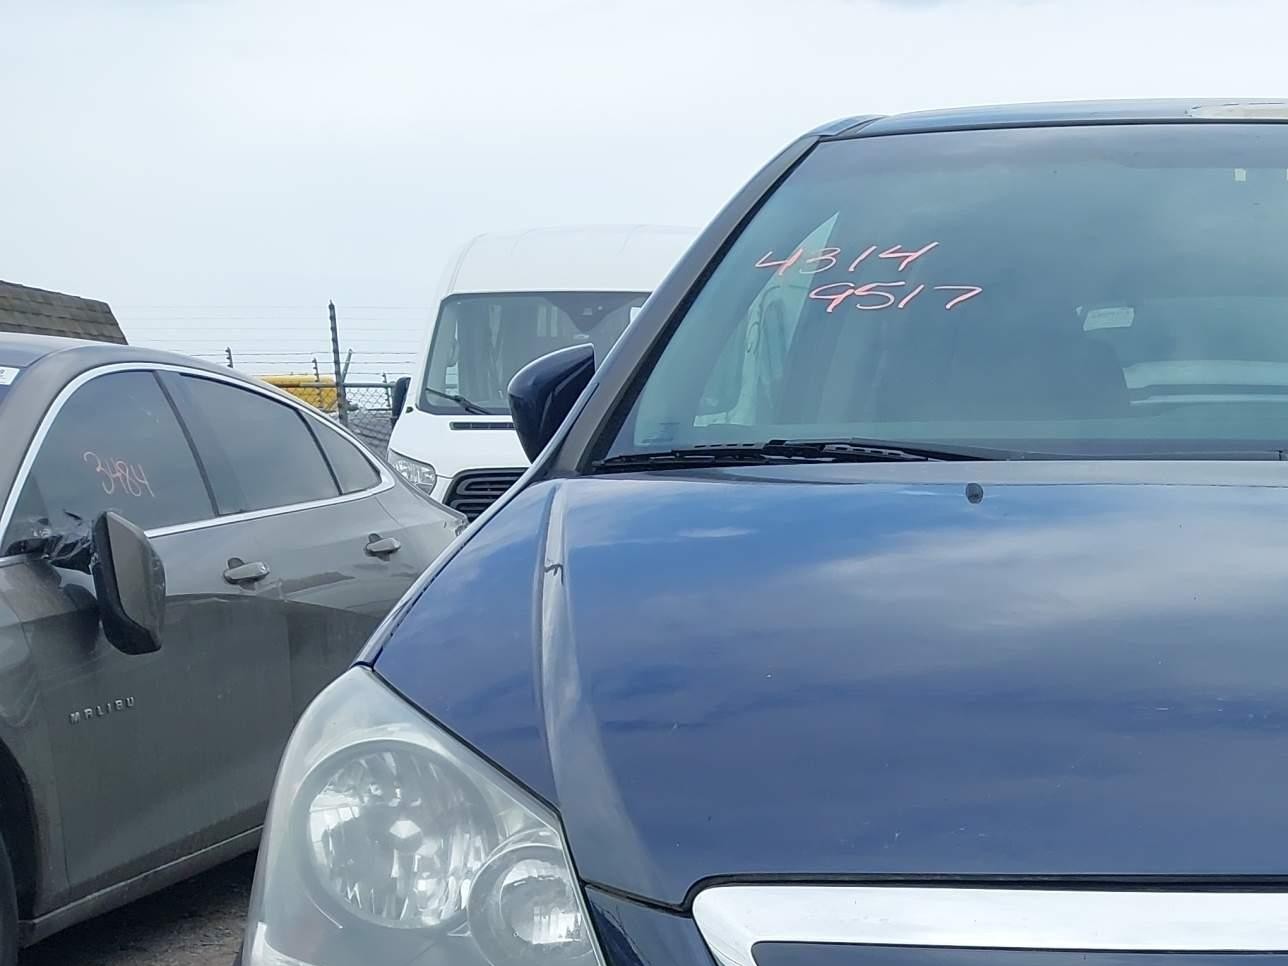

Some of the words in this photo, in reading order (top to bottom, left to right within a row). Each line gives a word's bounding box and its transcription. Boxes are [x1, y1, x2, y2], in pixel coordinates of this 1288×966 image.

[755, 241, 940, 276] 4314
[808, 281, 983, 313] 9517
[68, 696, 135, 725] MALIBU
